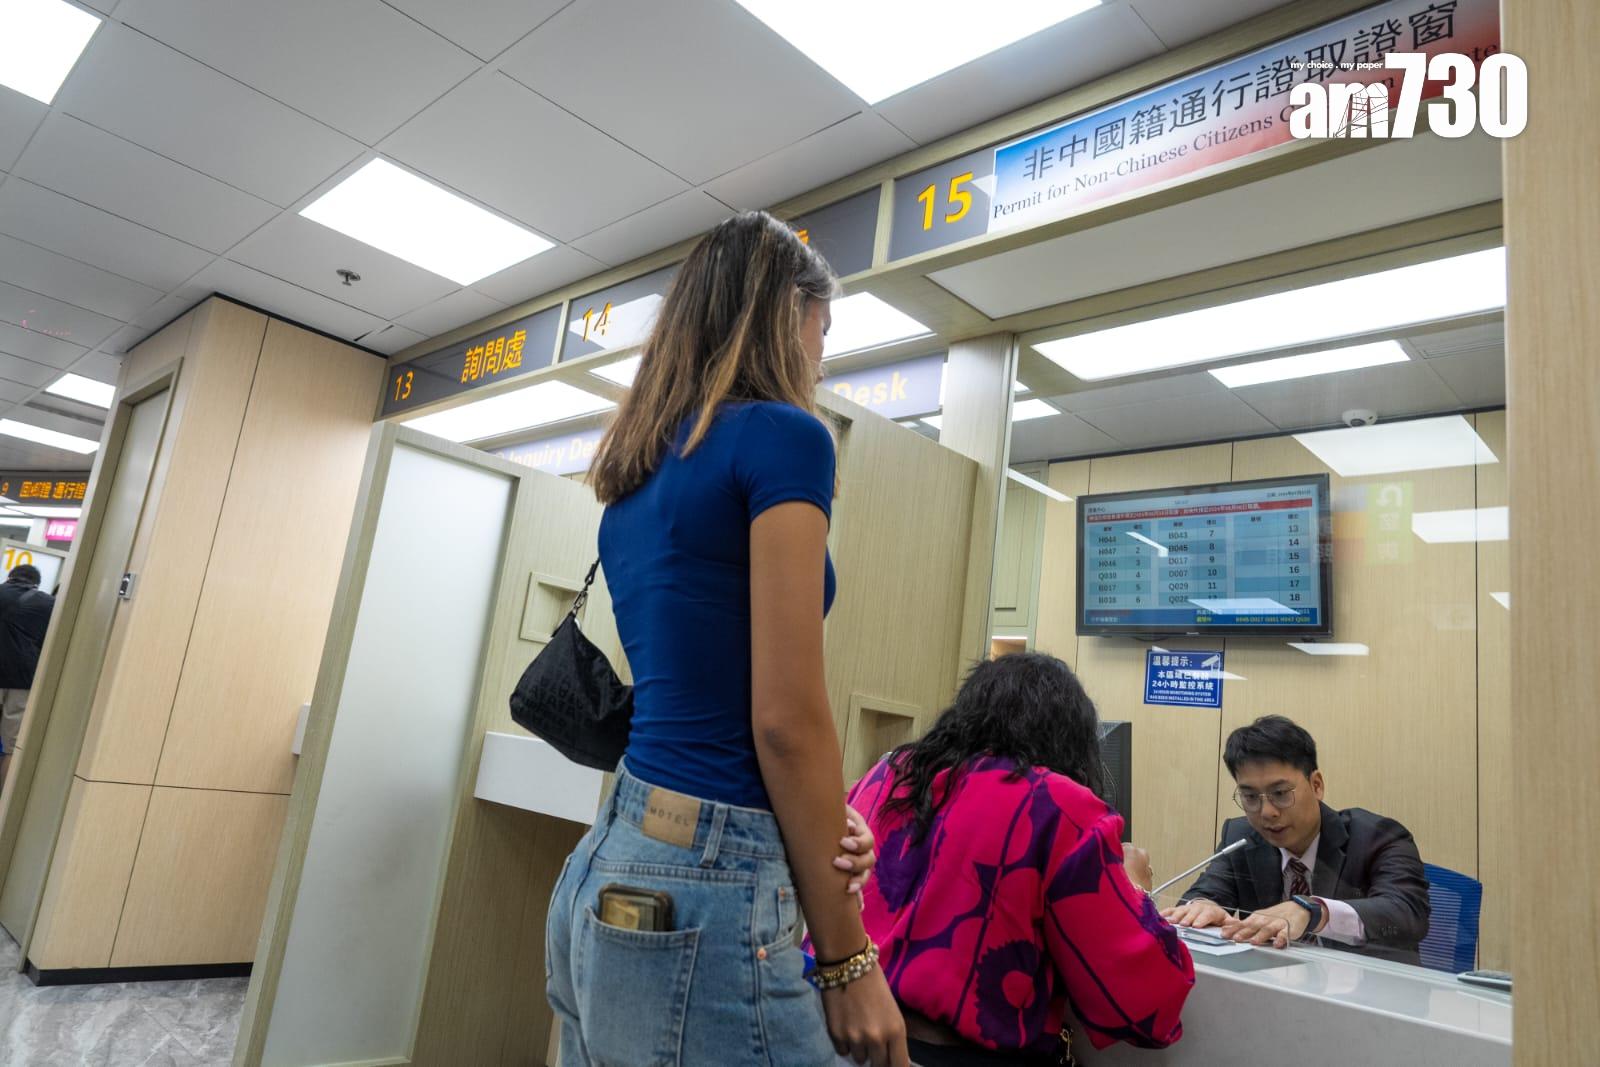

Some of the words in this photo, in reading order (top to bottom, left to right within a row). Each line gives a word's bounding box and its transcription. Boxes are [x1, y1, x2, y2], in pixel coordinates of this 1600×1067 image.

[993, 190, 1041, 219] Permit
[1047, 183, 1070, 201] for
[1073, 144, 1188, 192] Non-Chinese
[1193, 115, 1273, 150] Citizens
[917, 171, 974, 232] 15
[583, 301, 612, 342] 14
[460, 330, 527, 384] 詢問處
[394, 370, 414, 401] 13
[650, 806, 690, 827] MOTEL
